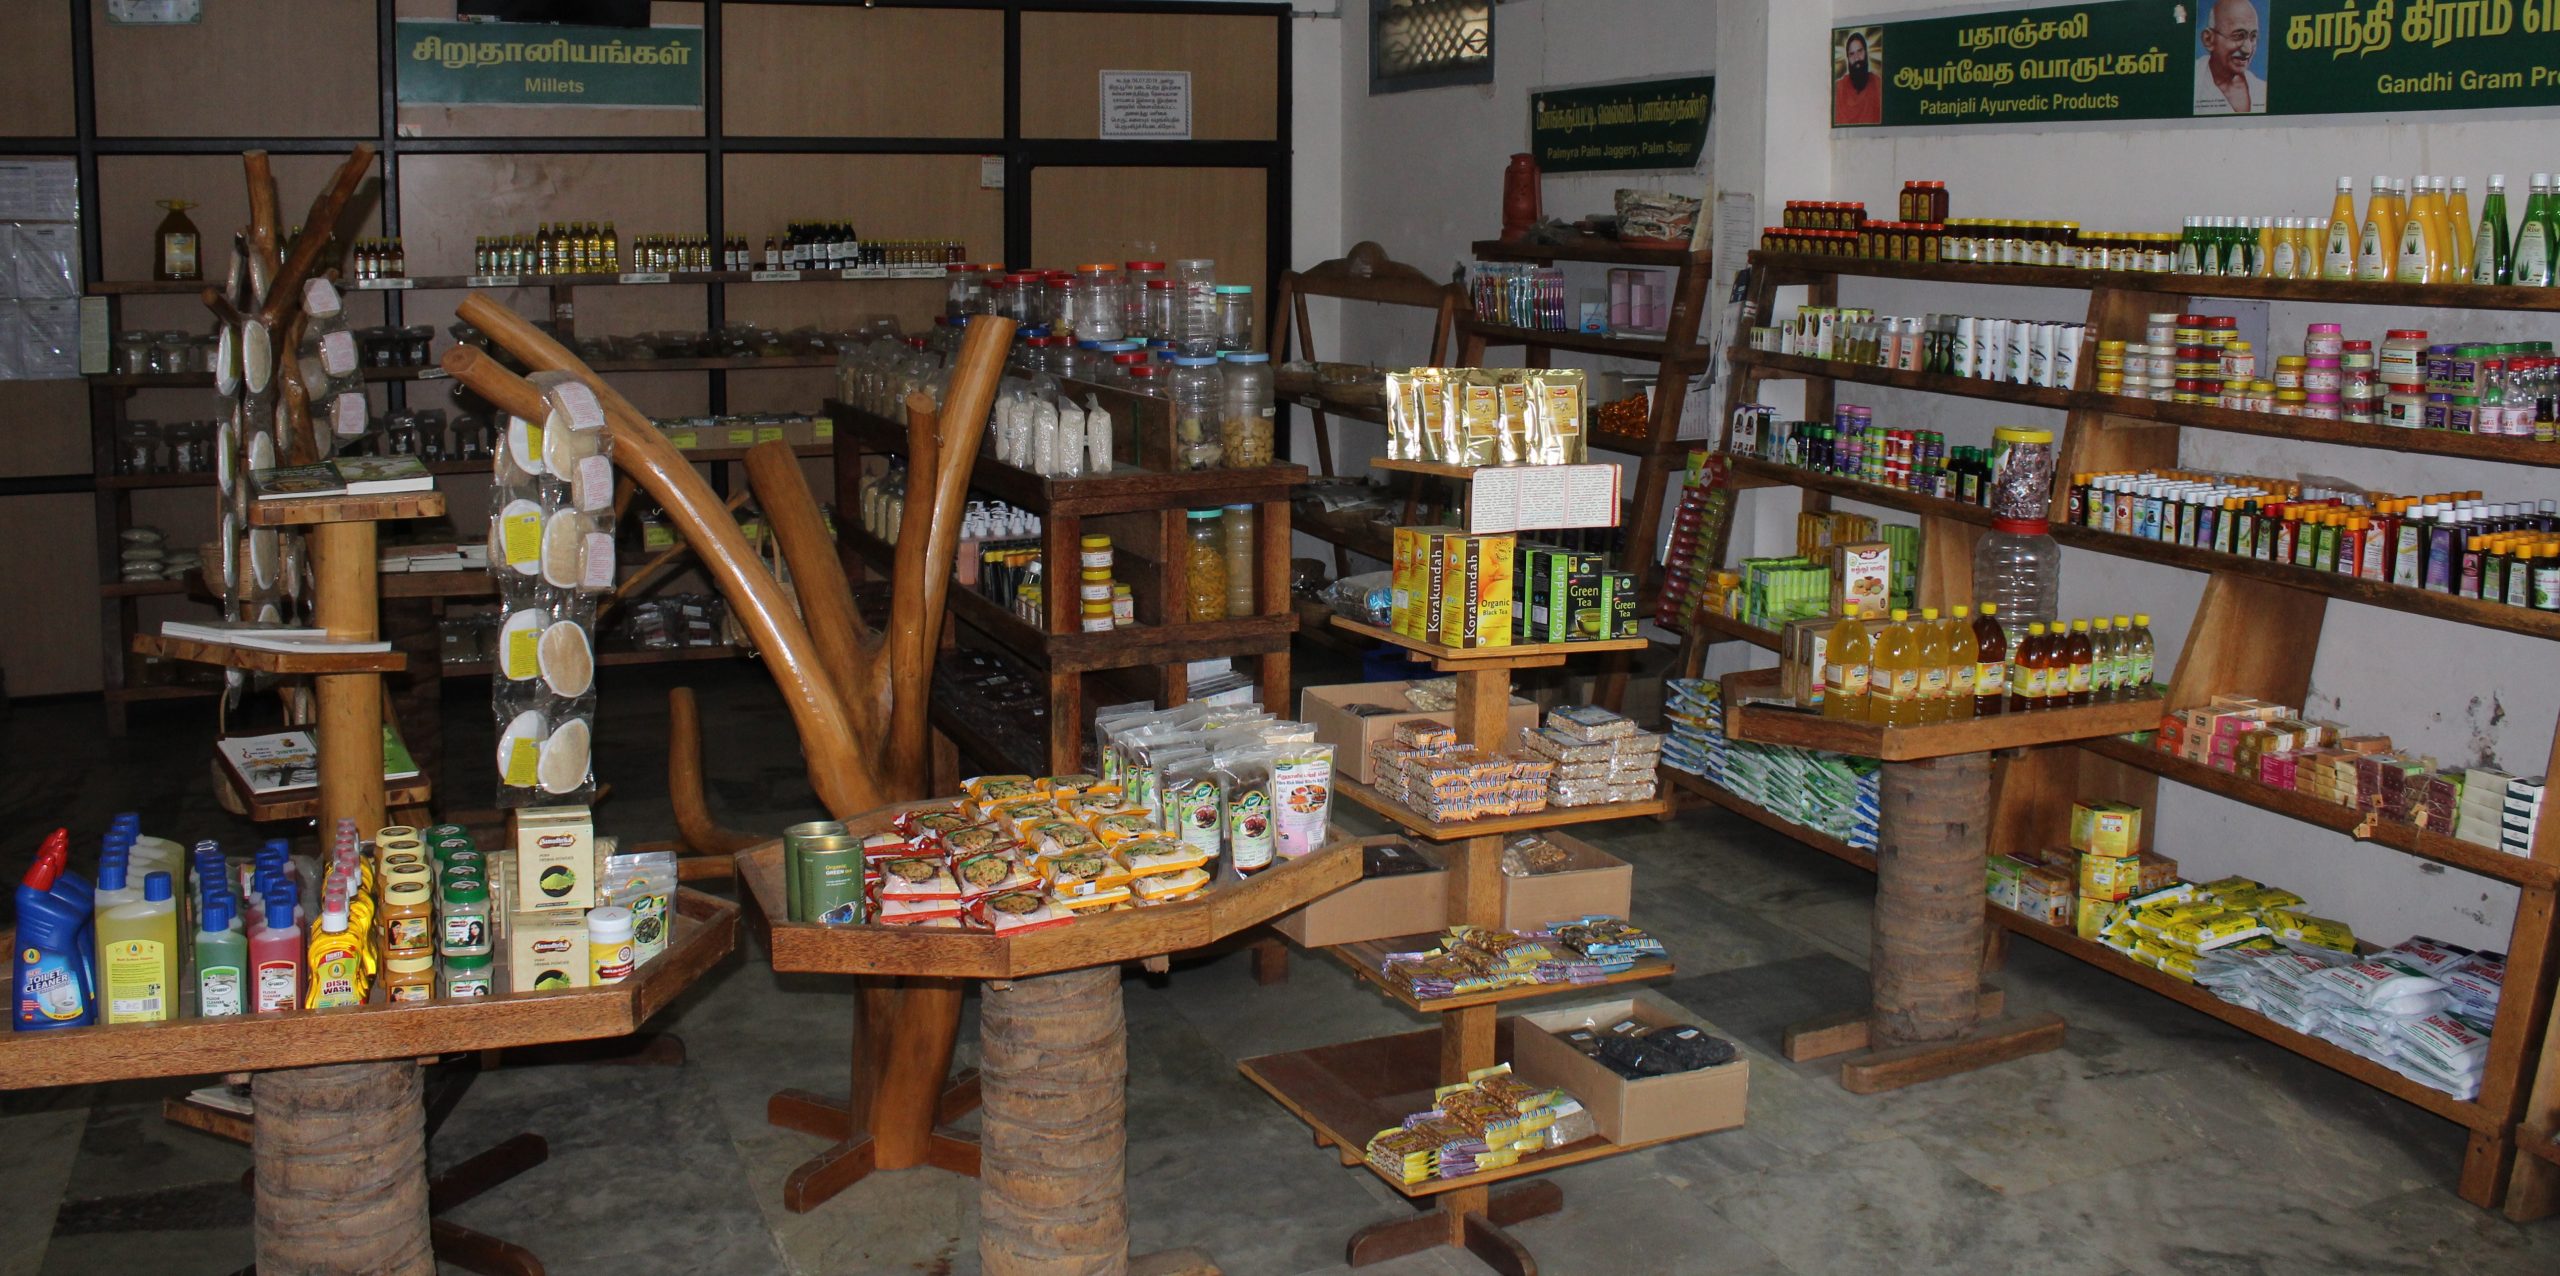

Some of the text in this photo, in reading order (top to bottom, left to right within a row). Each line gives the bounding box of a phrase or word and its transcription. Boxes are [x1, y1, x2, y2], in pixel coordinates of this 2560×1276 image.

[1958, 12, 2089, 53] பதாஞ்சலி
[2287, 0, 2394, 61] காந்தி
[412, 36, 692, 69] சிறுதானியங்கள்
[1893, 47, 2169, 91] ஆயுர்வேத பொருட்கள்
[525, 77, 584, 93] Millets
[2377, 71, 2453, 95] Gandhi
[2460, 69, 2523, 91] Gram
[1920, 92, 2120, 118] Patanjali Ayurvedic Products
[1547, 140, 1692, 160] Palmyra Palm Jaggery, Palm Sugar
[1428, 550, 1443, 632] Korakundah
[1464, 555, 1478, 639] Korakundah
[1570, 585, 1599, 597] Green
[1481, 598, 1510, 608] Organic
[1552, 566, 1565, 640] Korakundah
[1577, 597, 1592, 607] Tea
[1614, 600, 1636, 610] Green
[1482, 608, 1498, 616] Black
[1619, 610, 1631, 618] Tea
[825, 863, 847, 871] Organic
[25, 974, 69, 993] CLEANER
[28, 969, 62, 985] TOILET
[326, 980, 349, 988] DISH
[323, 986, 352, 995] WASH
